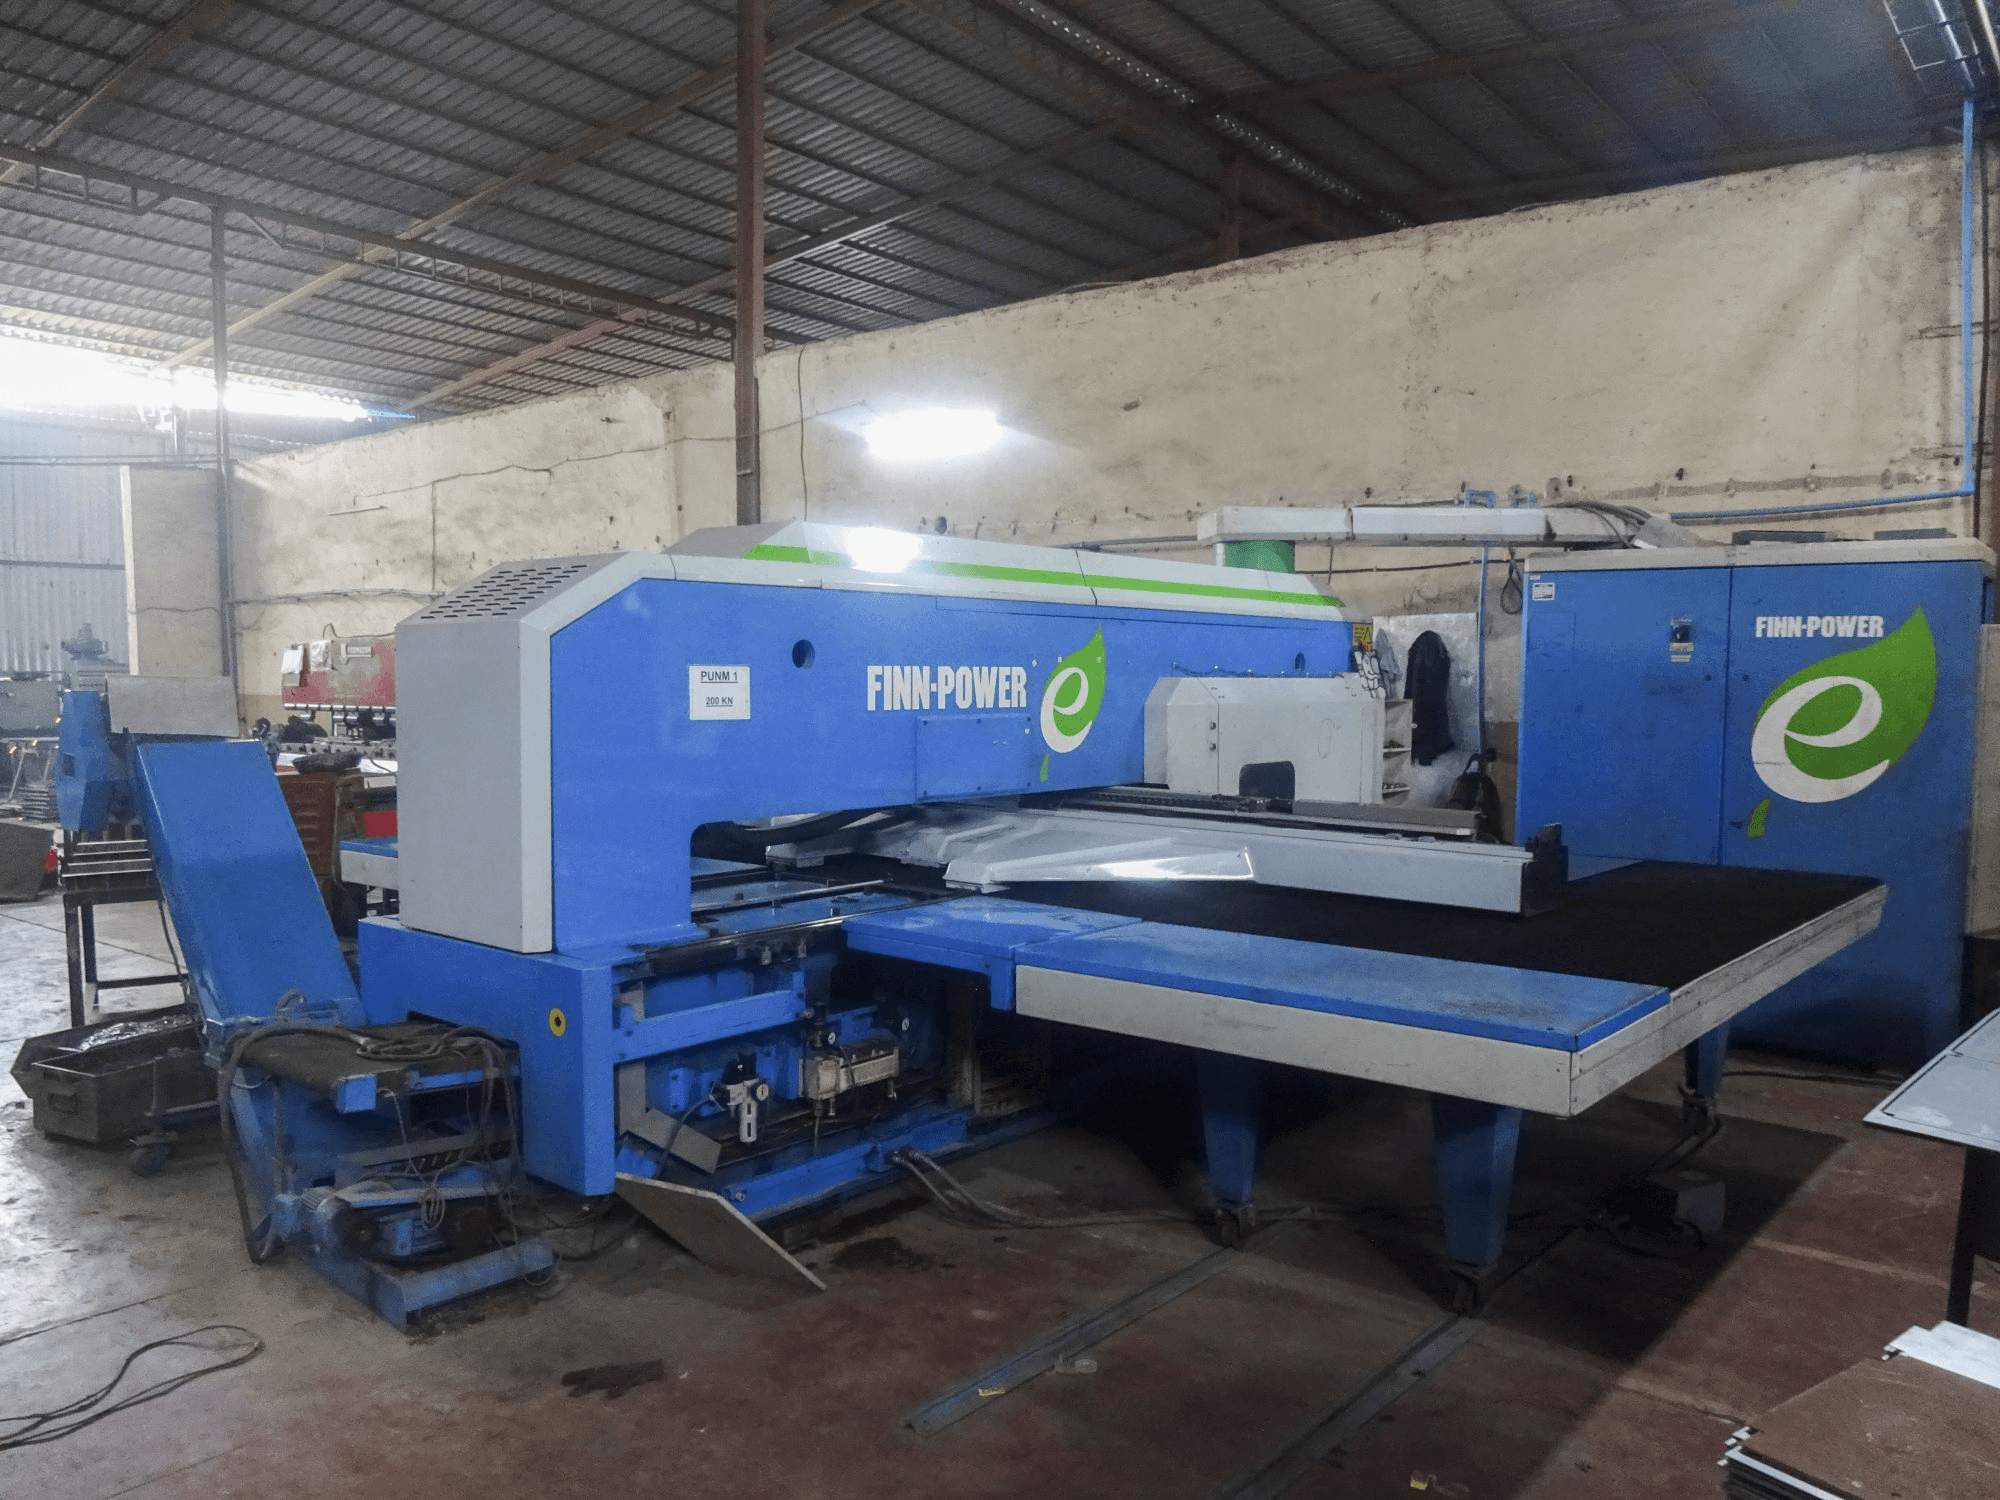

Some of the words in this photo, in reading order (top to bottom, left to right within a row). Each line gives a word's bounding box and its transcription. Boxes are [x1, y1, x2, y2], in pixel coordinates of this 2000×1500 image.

[1755, 615, 1884, 638] FINN-POWER
[700, 670, 730, 681] PUNM
[733, 671, 738, 681] 1
[867, 665, 1027, 711] FINN-POWER
[705, 696, 720, 705] 200
[721, 696, 734, 705] KN
